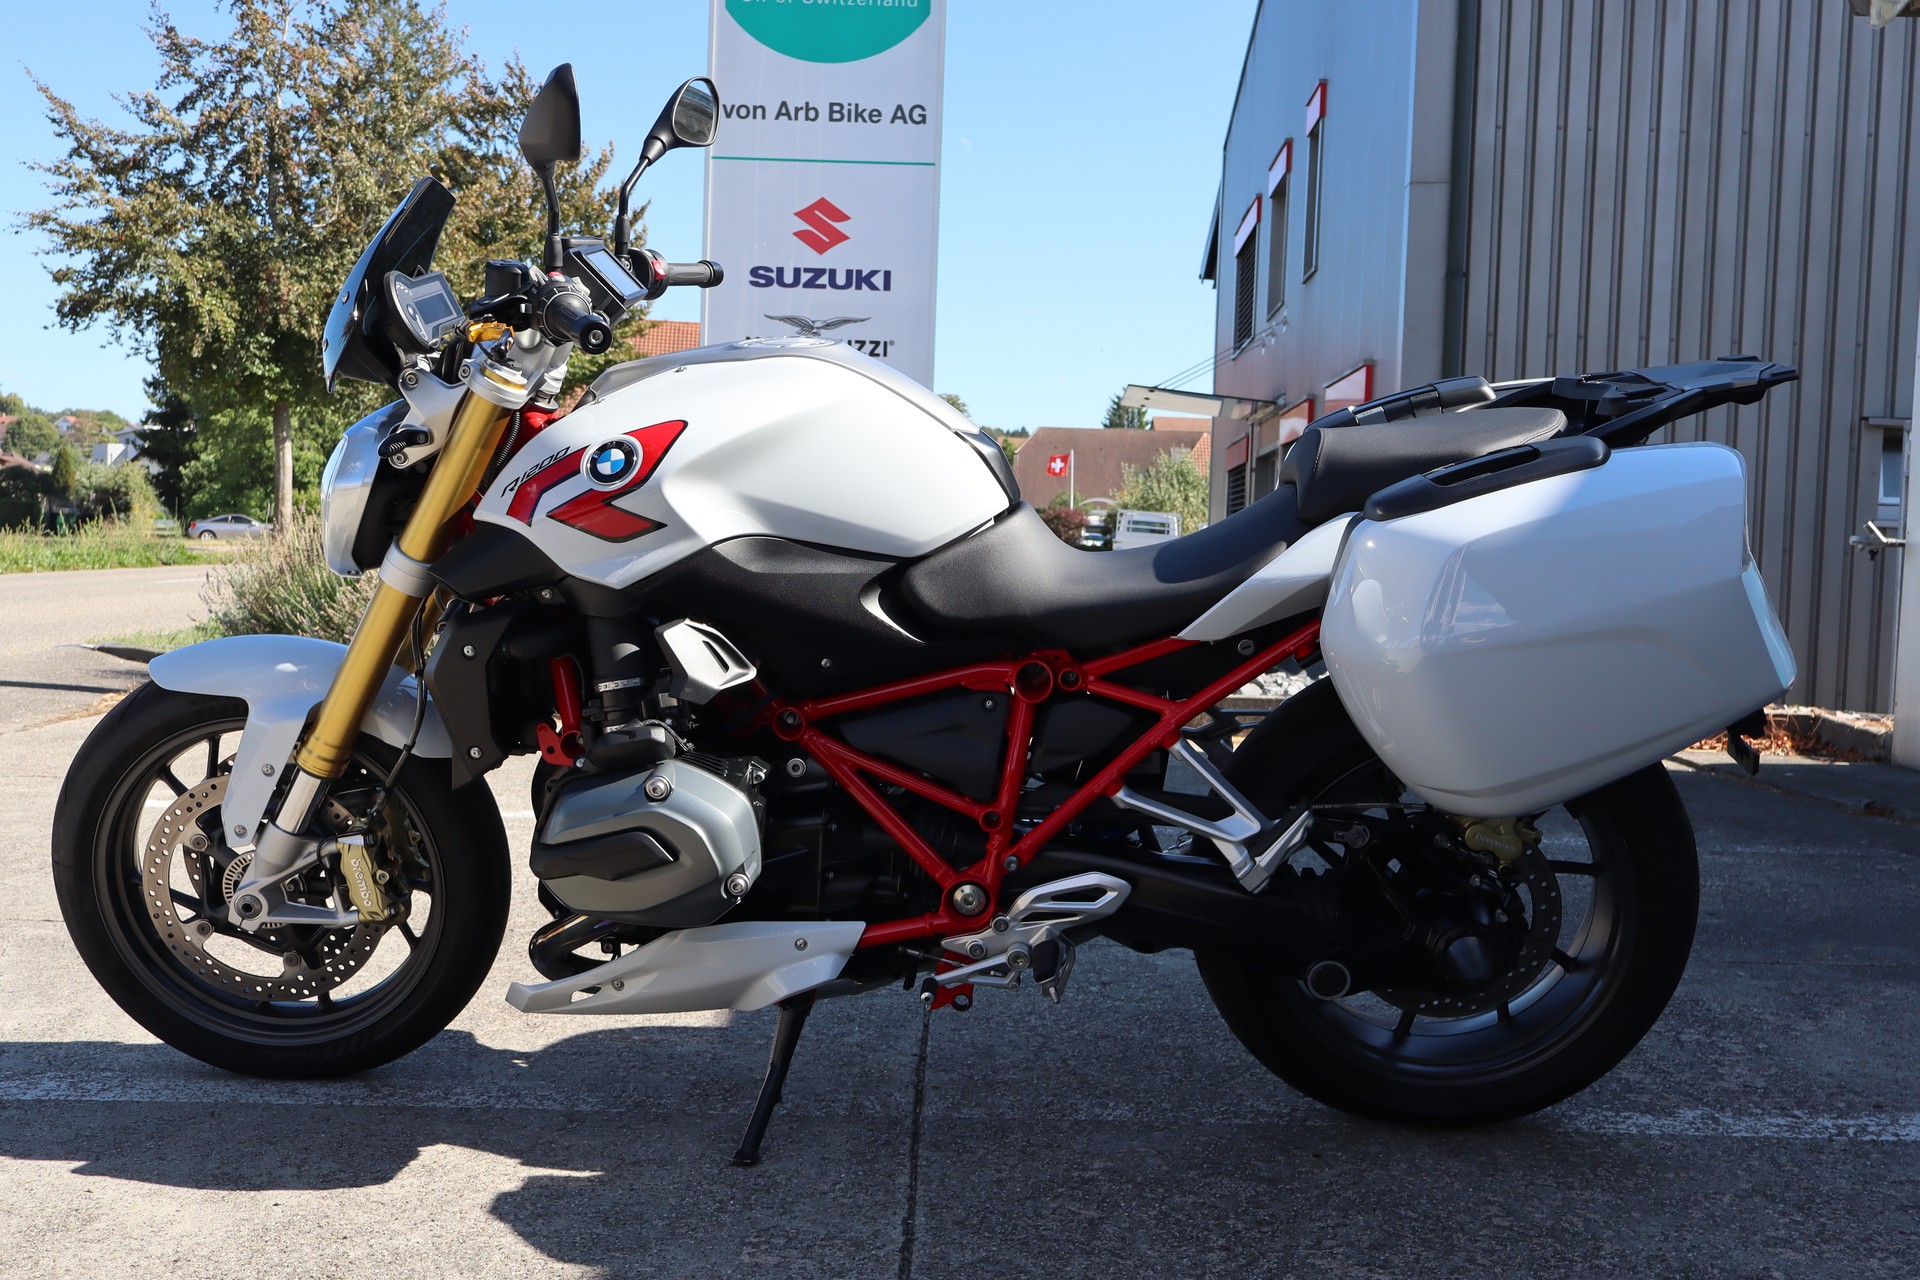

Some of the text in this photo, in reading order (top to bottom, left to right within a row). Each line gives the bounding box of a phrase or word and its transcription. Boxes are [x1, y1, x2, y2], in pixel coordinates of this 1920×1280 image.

[722, 100, 927, 125] von Arb Bike AG
[749, 265, 892, 292] SUZUKI
[350, 857, 372, 907] brembo
